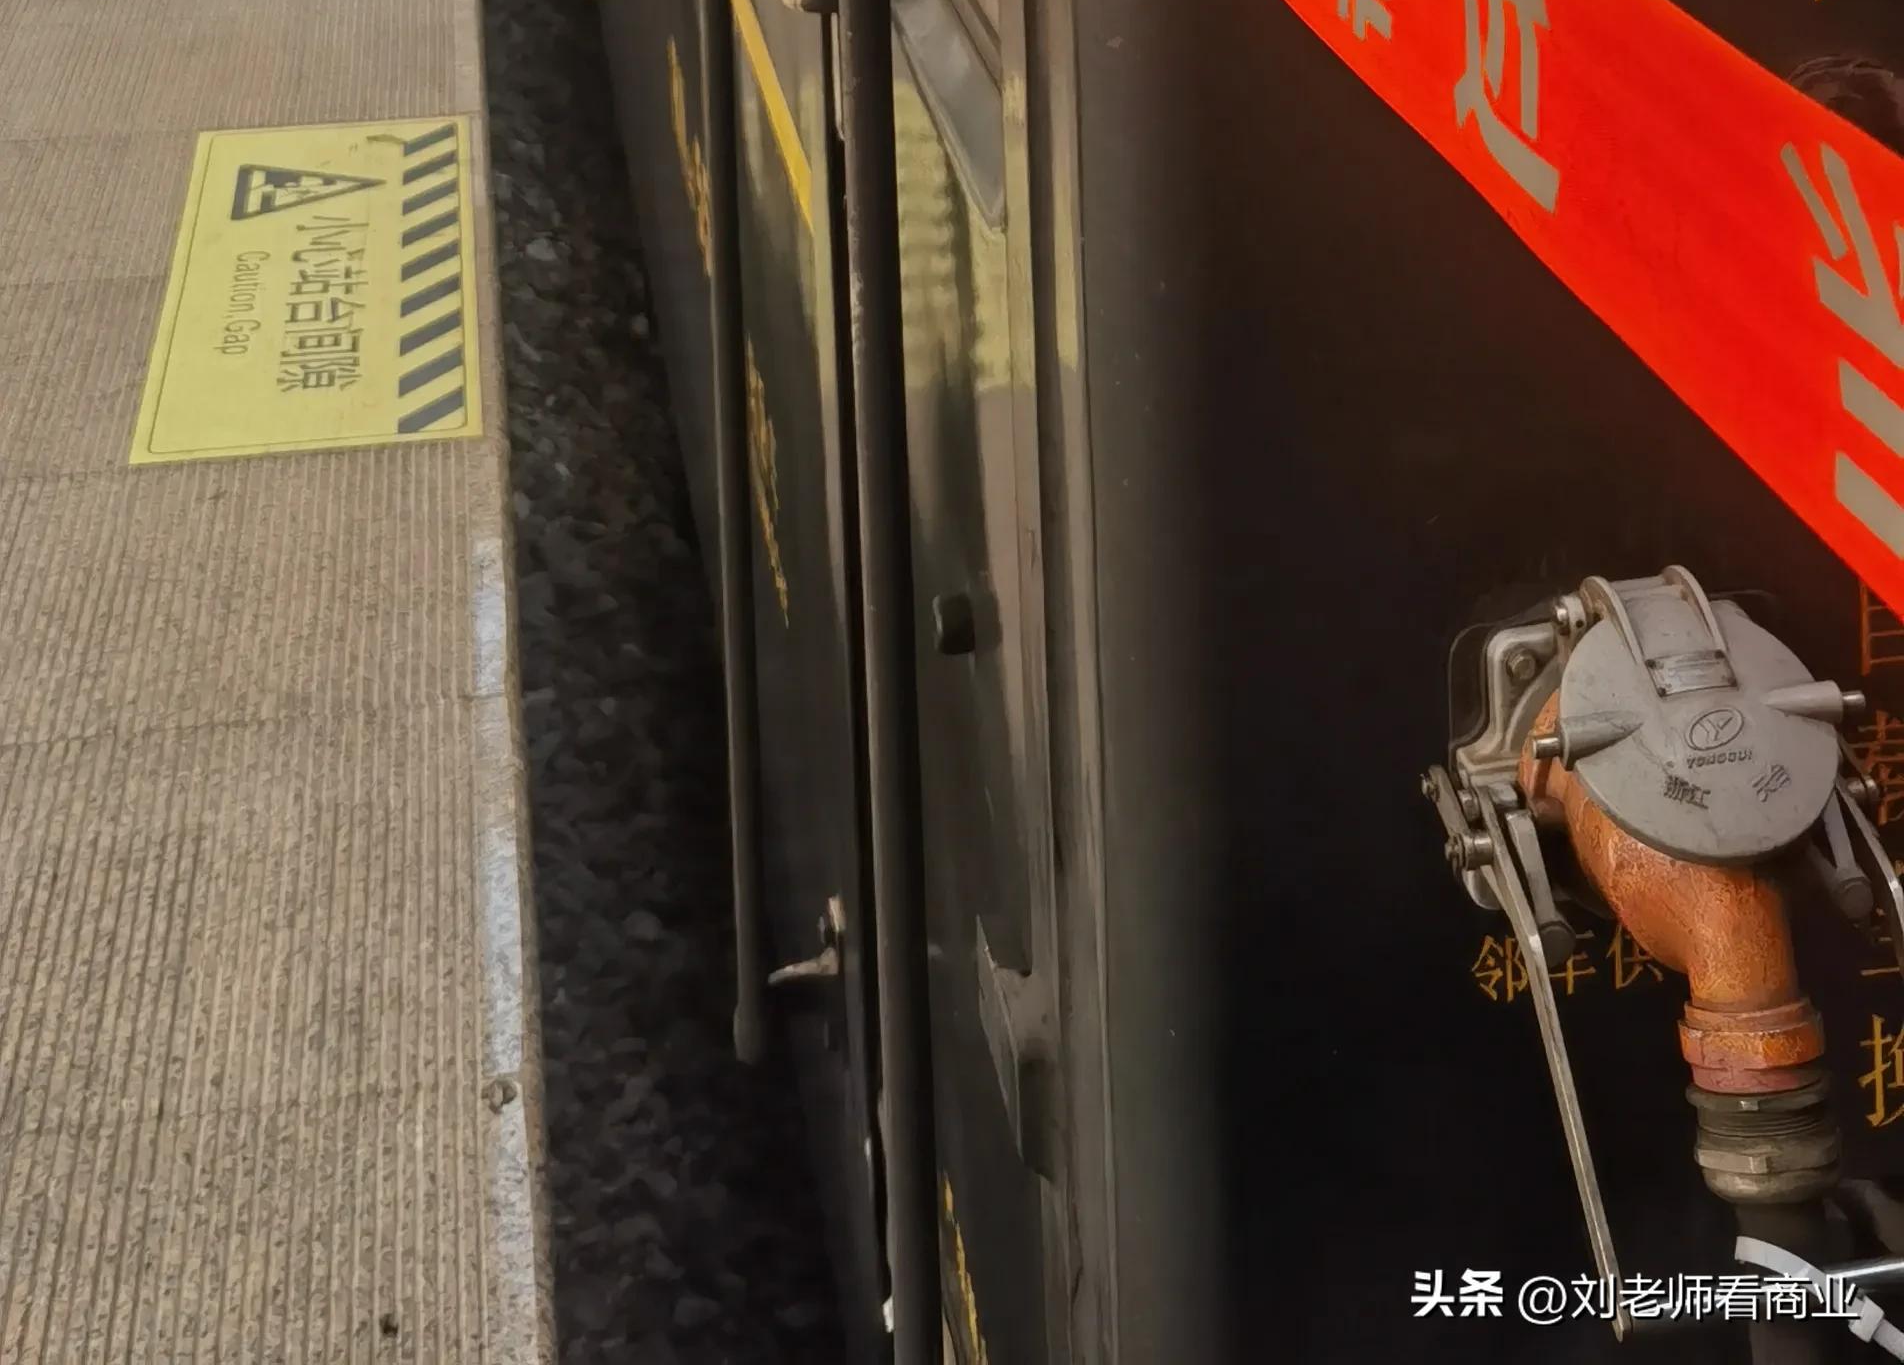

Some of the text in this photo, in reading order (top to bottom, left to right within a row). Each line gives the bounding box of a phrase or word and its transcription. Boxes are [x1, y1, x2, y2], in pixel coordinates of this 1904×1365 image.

[276, 215, 370, 392] 小心站台间隙
